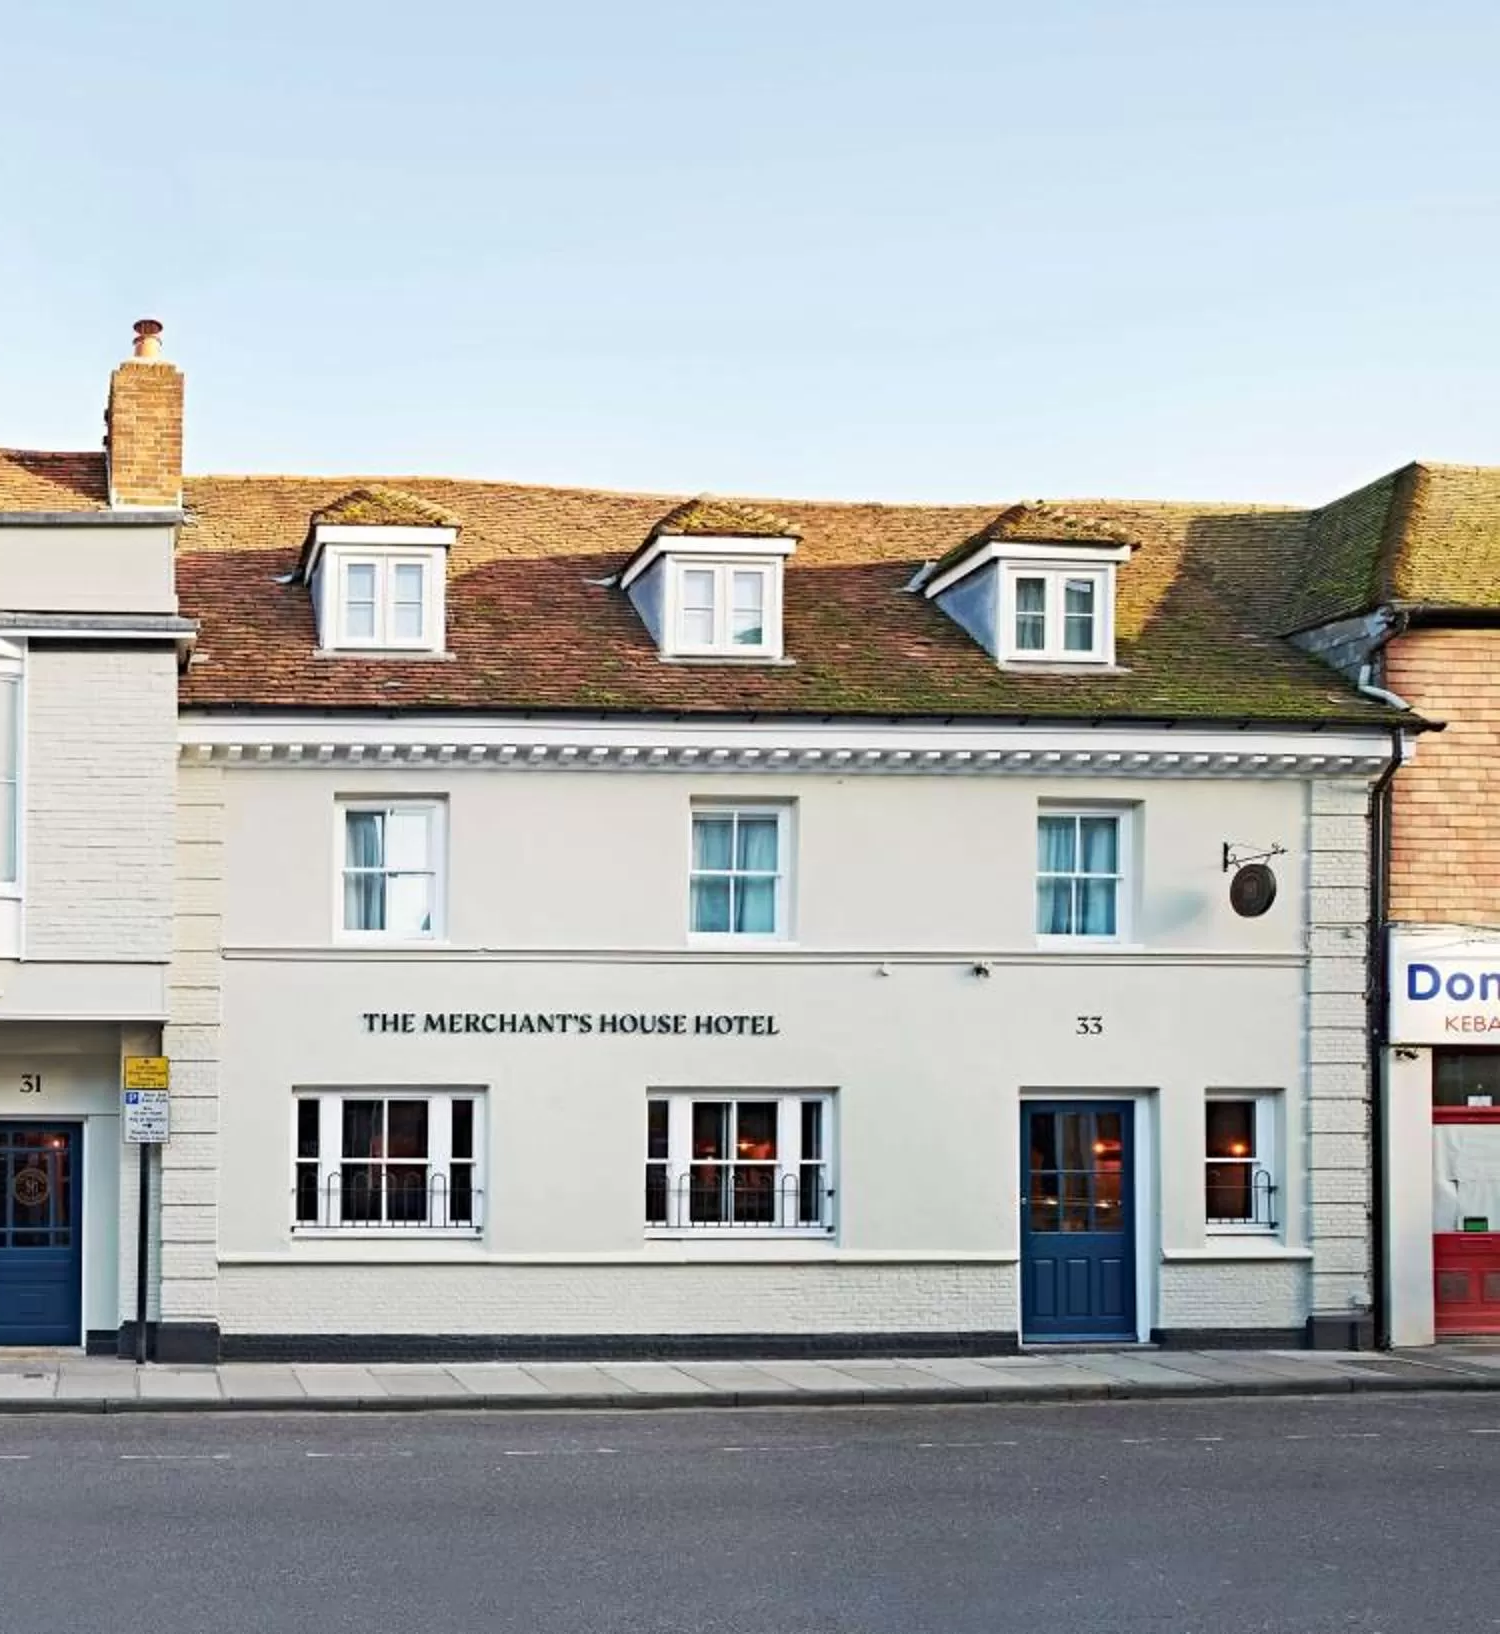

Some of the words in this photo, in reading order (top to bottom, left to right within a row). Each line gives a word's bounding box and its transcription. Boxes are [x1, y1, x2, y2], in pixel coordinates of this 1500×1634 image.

[362, 1013, 416, 1034] THE
[423, 1013, 593, 1034] MERCHANT'S
[599, 1013, 687, 1035] HOUSE
[694, 1015, 780, 1036] HOTEL
[1075, 1015, 1103, 1035] 33
[1445, 1015, 1500, 1033] KEBA
[19, 1073, 42, 1094] 31
